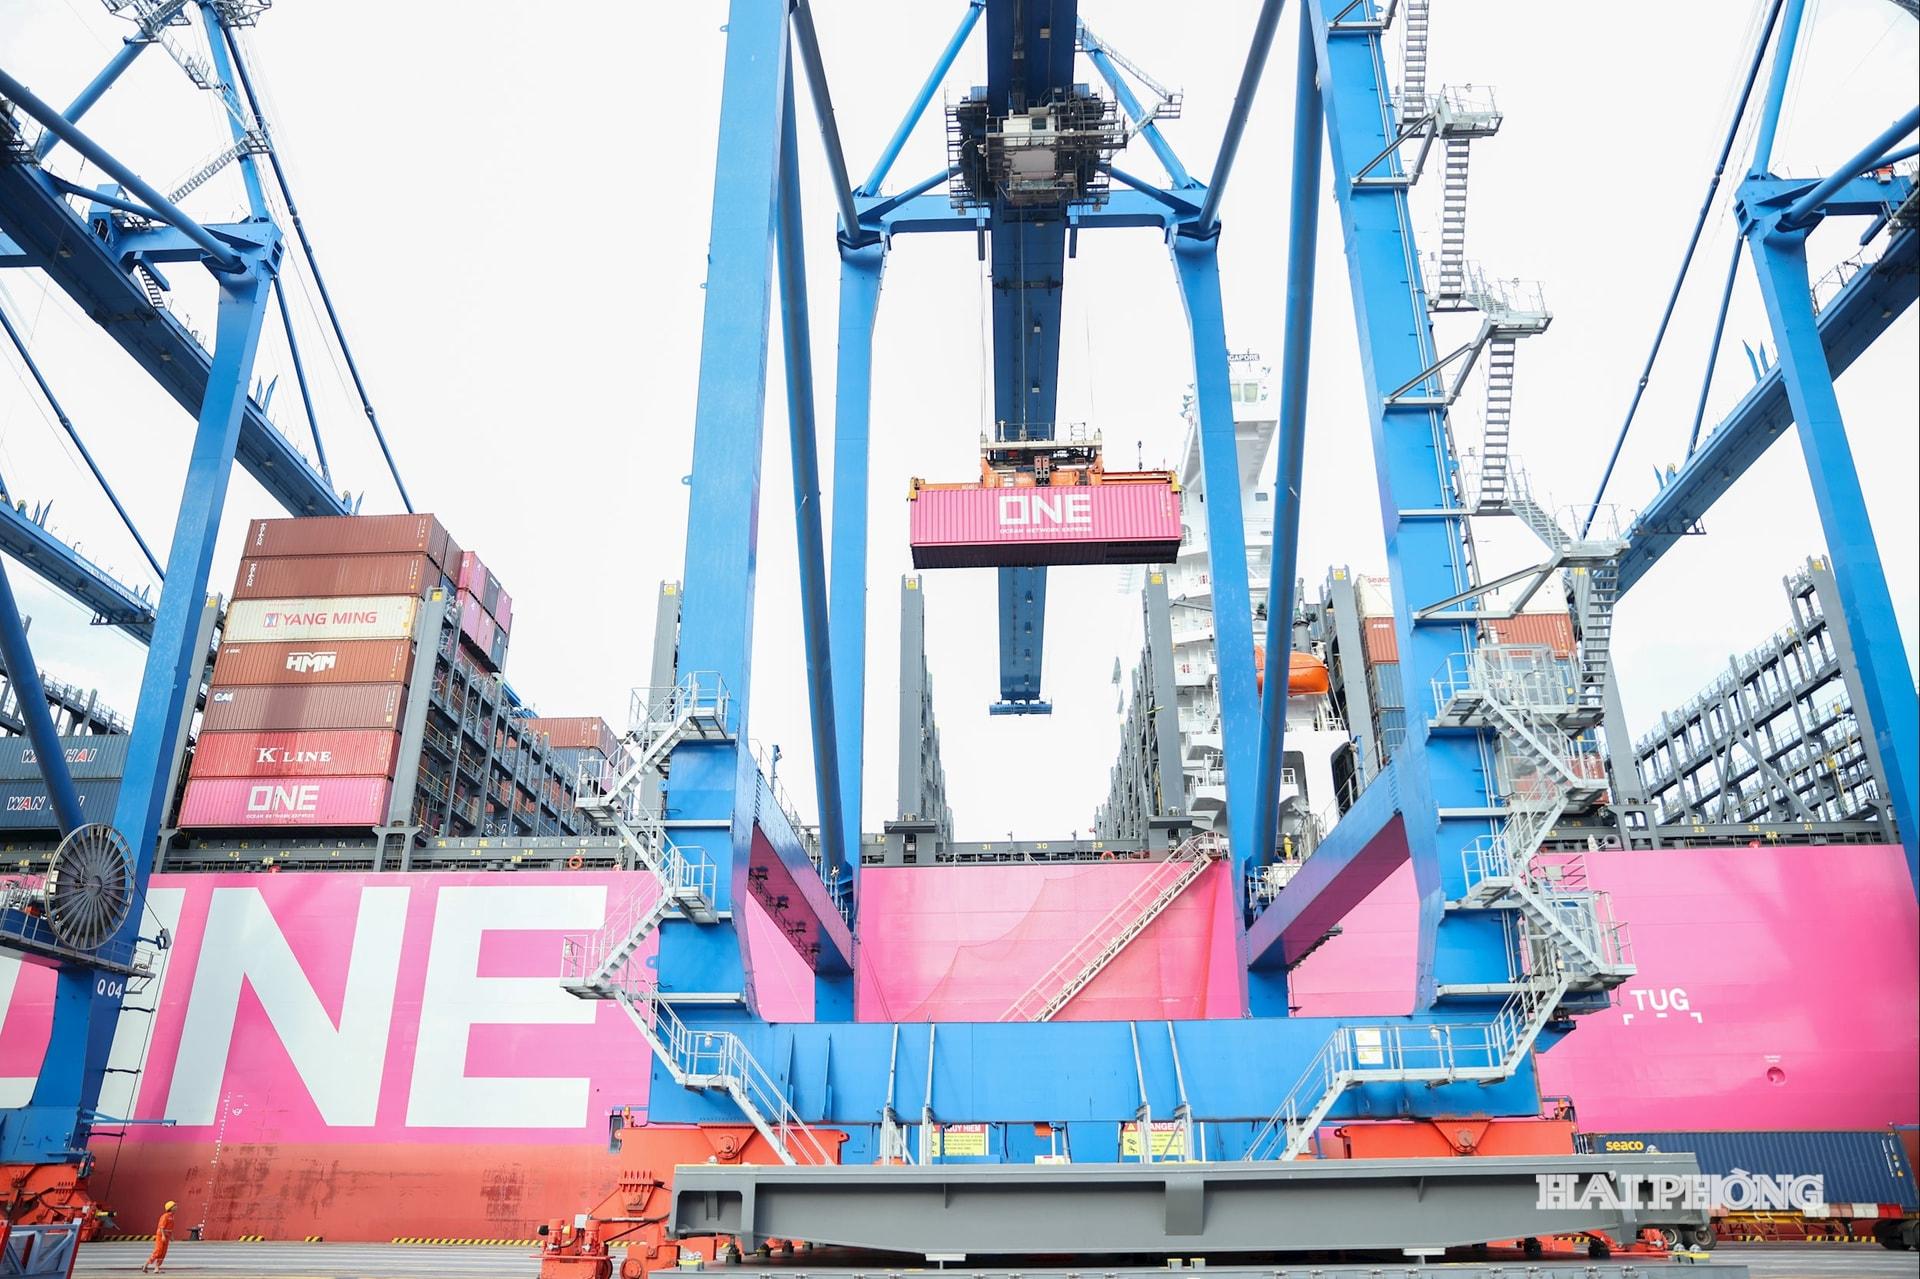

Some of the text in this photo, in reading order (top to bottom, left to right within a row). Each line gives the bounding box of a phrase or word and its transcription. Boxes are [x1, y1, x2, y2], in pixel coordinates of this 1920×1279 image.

[999, 494, 1091, 525] ONE
[283, 611, 377, 626] YANG MING
[286, 651, 337, 673] HMM
[214, 692, 233, 703] CAI
[283, 750, 332, 763] LINE
[7, 795, 46, 811] WAN
[247, 784, 320, 812] ONE
[97, 978, 123, 998] Q 04
[1629, 988, 1690, 1012] TUG
[1149, 1122, 1178, 1131] ANGE
[1605, 1140, 1645, 1151] seaco
